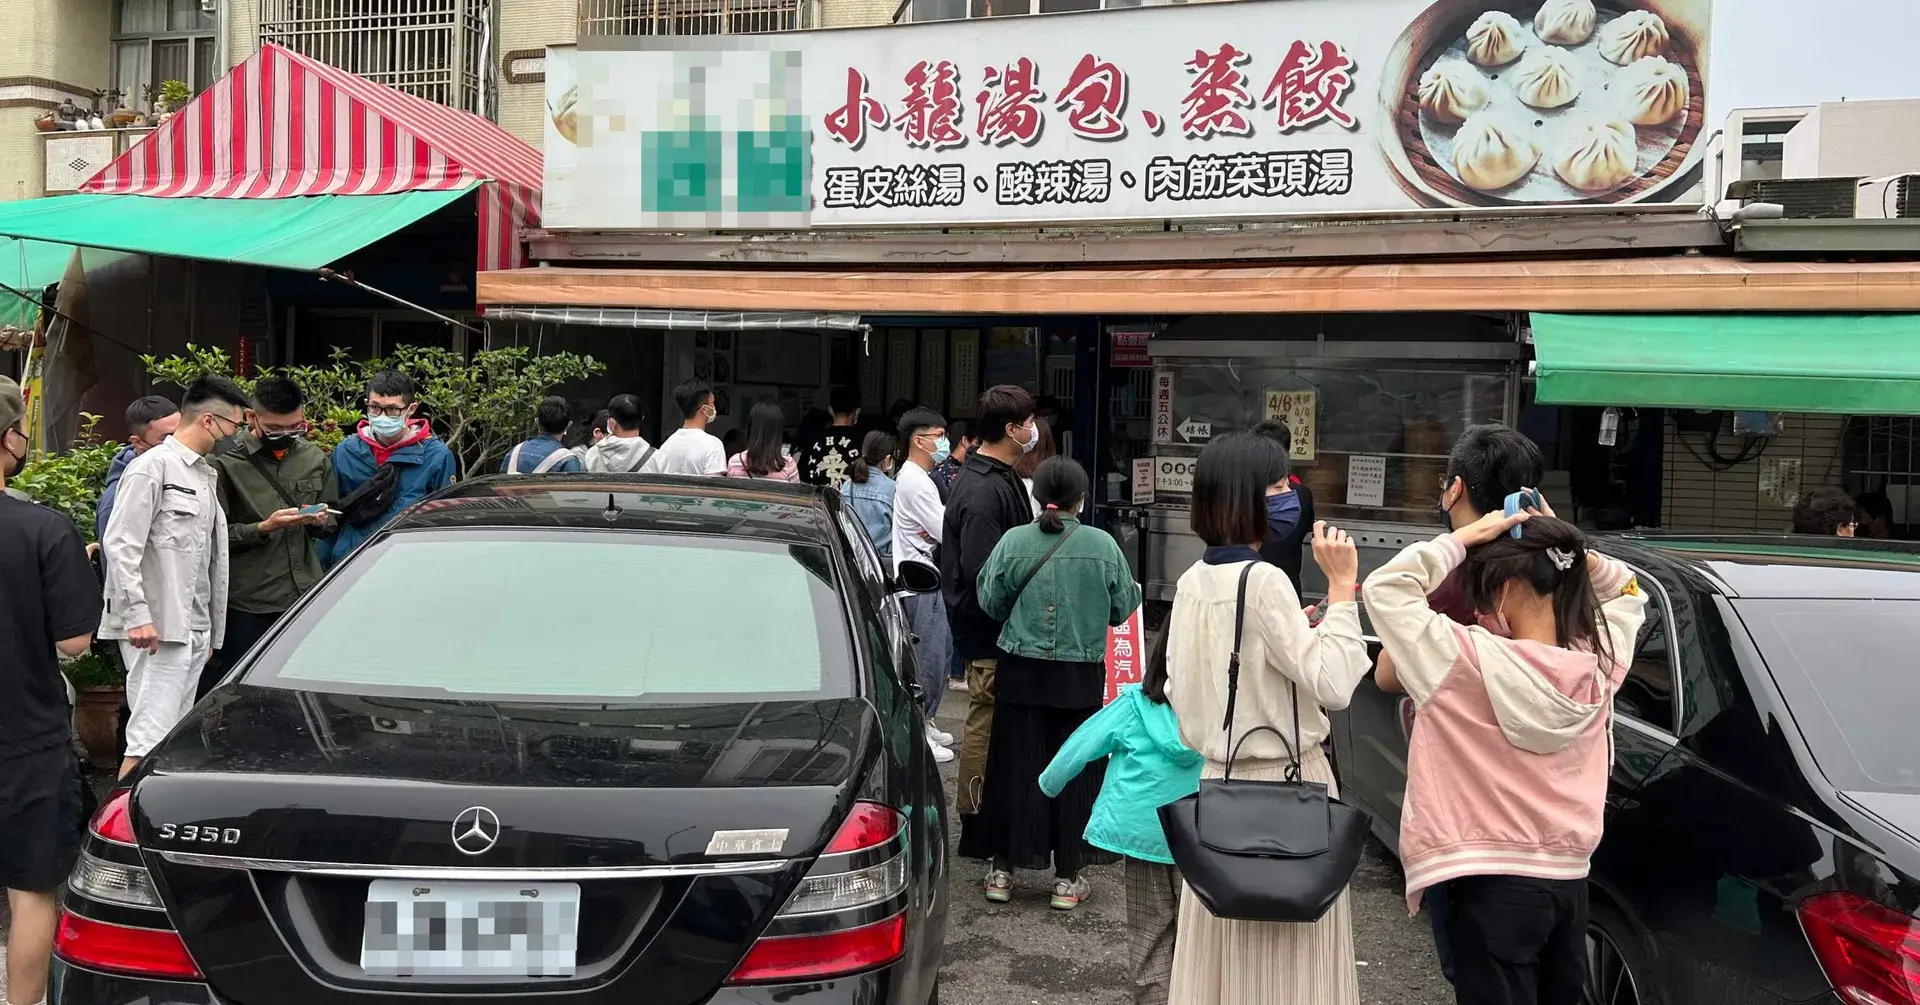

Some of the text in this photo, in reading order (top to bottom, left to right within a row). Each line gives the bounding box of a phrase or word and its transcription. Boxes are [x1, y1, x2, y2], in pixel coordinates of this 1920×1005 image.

[824, 39, 1356, 146] 小籠湯包、蒸餃
[825, 149, 1353, 207] 蛋皮絲湯、酸辣湯、肉筋菜頭湯
[1157, 376, 1170, 438] 每週五公休
[1269, 394, 1292, 412] 4/6
[1294, 406, 1311, 418] 4/4
[1184, 424, 1209, 436] 結帳
[1294, 425, 1310, 437] 4/5
